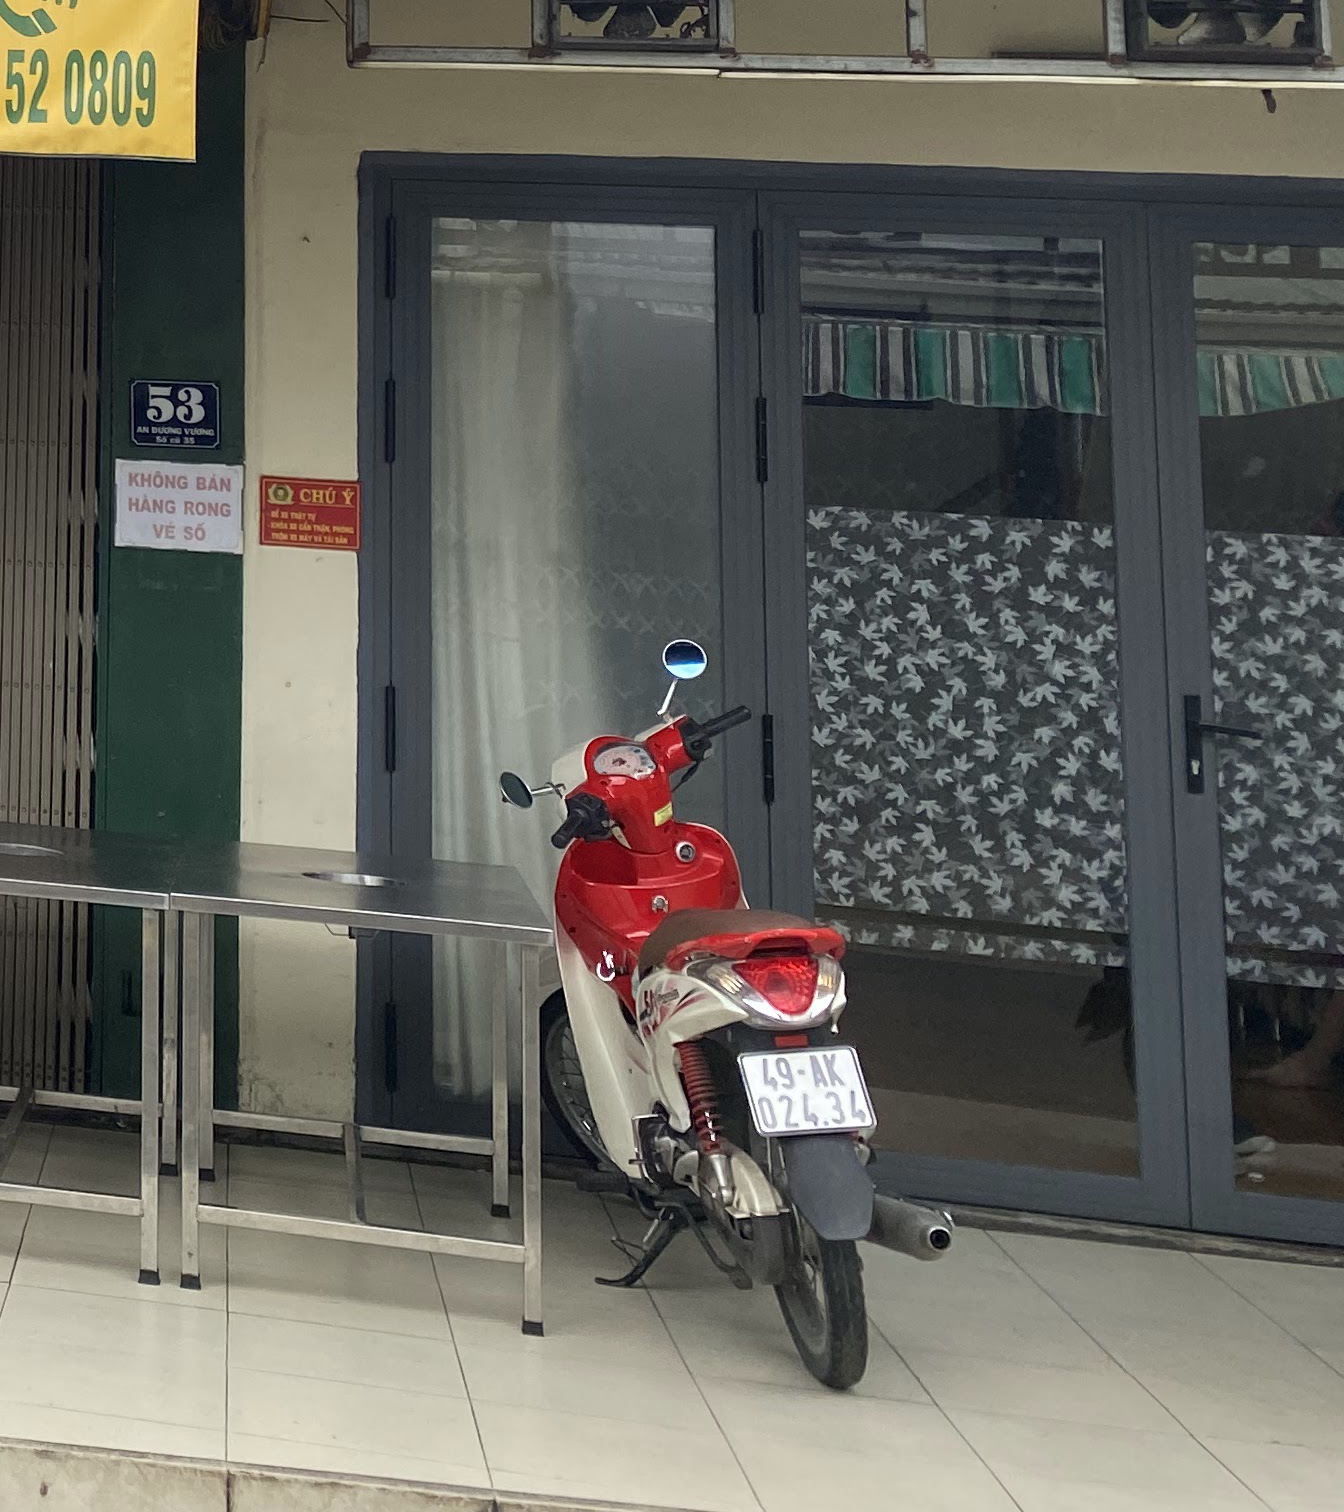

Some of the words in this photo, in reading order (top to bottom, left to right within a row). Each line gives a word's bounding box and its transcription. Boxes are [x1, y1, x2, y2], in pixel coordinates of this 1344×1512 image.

[5, 48, 49, 125] 52
[64, 48, 157, 128] 0809
[146, 384, 206, 424] 53
[136, 426, 150, 434] AN
[151, 426, 183, 435] DƯƠNG
[183, 427, 215, 437] VƯƠNG
[128, 471, 188, 490] KHÔNG
[196, 474, 231, 492] BÁN
[127, 494, 176, 514] HÀNG
[183, 500, 231, 518] RONG
[299, 487, 336, 505] CHÚ
[342, 488, 355, 505] Ý
[153, 521, 176, 540] VÉ
[183, 522, 206, 541] SỐ
[762, 1054, 845, 1089] 49-AK
[758, 1091, 866, 1129] 024.34
